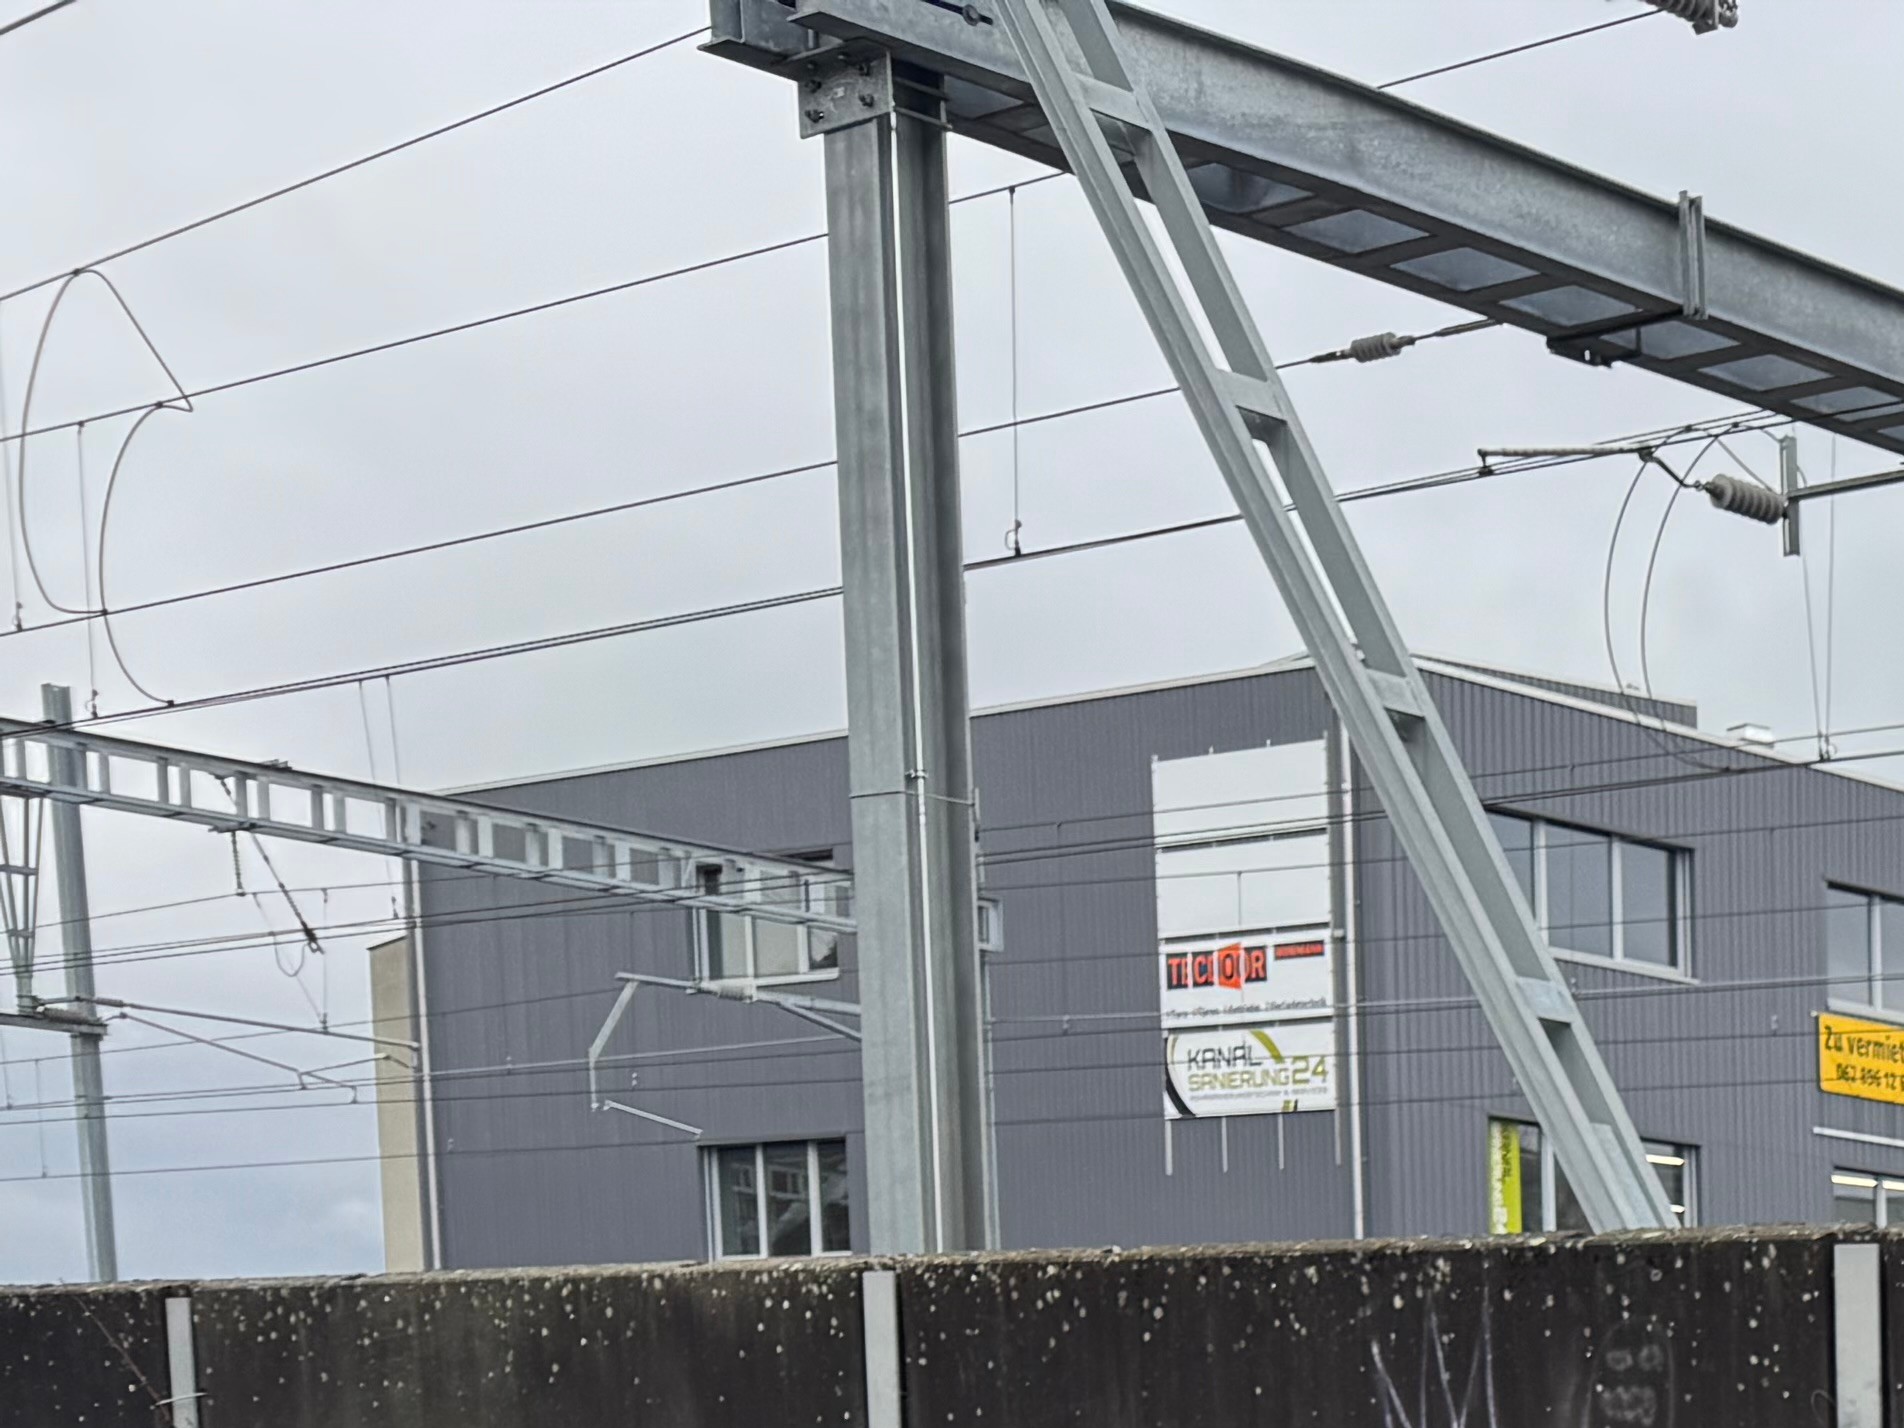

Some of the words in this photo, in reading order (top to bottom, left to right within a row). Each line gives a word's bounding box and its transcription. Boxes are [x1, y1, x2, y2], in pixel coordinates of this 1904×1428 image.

[1825, 1025, 1843, 1051] Zu
[1187, 1044, 1262, 1072] KANAL
[1188, 1067, 1289, 1092] SANIERUNG
[1292, 1055, 1328, 1084] 24
